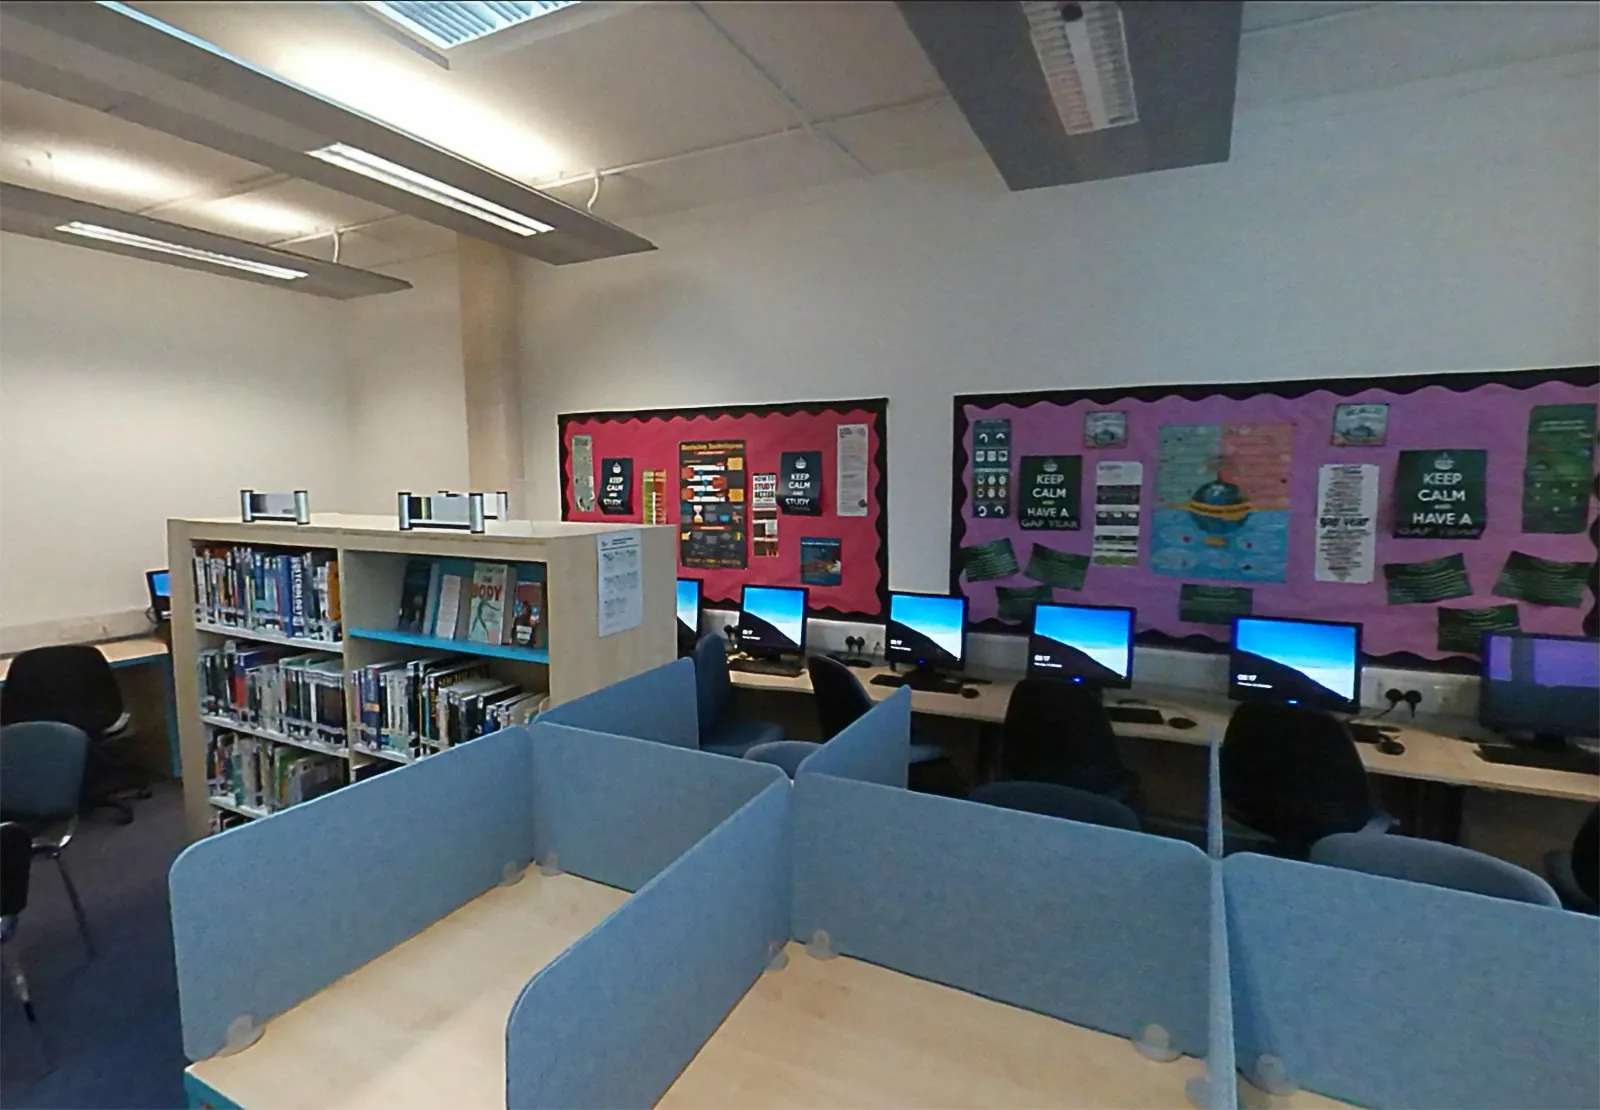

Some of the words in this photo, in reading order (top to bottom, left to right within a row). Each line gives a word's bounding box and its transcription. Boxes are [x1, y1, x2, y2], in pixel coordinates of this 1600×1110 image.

[1036, 473, 1065, 485] KEEP
[1423, 472, 1463, 485] KEEP
[788, 481, 811, 489] CALM
[1032, 488, 1067, 498] CALM
[1418, 489, 1466, 502] CALM
[1027, 507, 1057, 517] HAVE
[1060, 507, 1070, 517] A
[1021, 518, 1045, 527] GAP
[1047, 519, 1078, 529] YEAR
[1412, 512, 1456, 525] HAVE
[1459, 512, 1473, 525] A
[290, 556, 303, 615] PSYCHOLOGY
